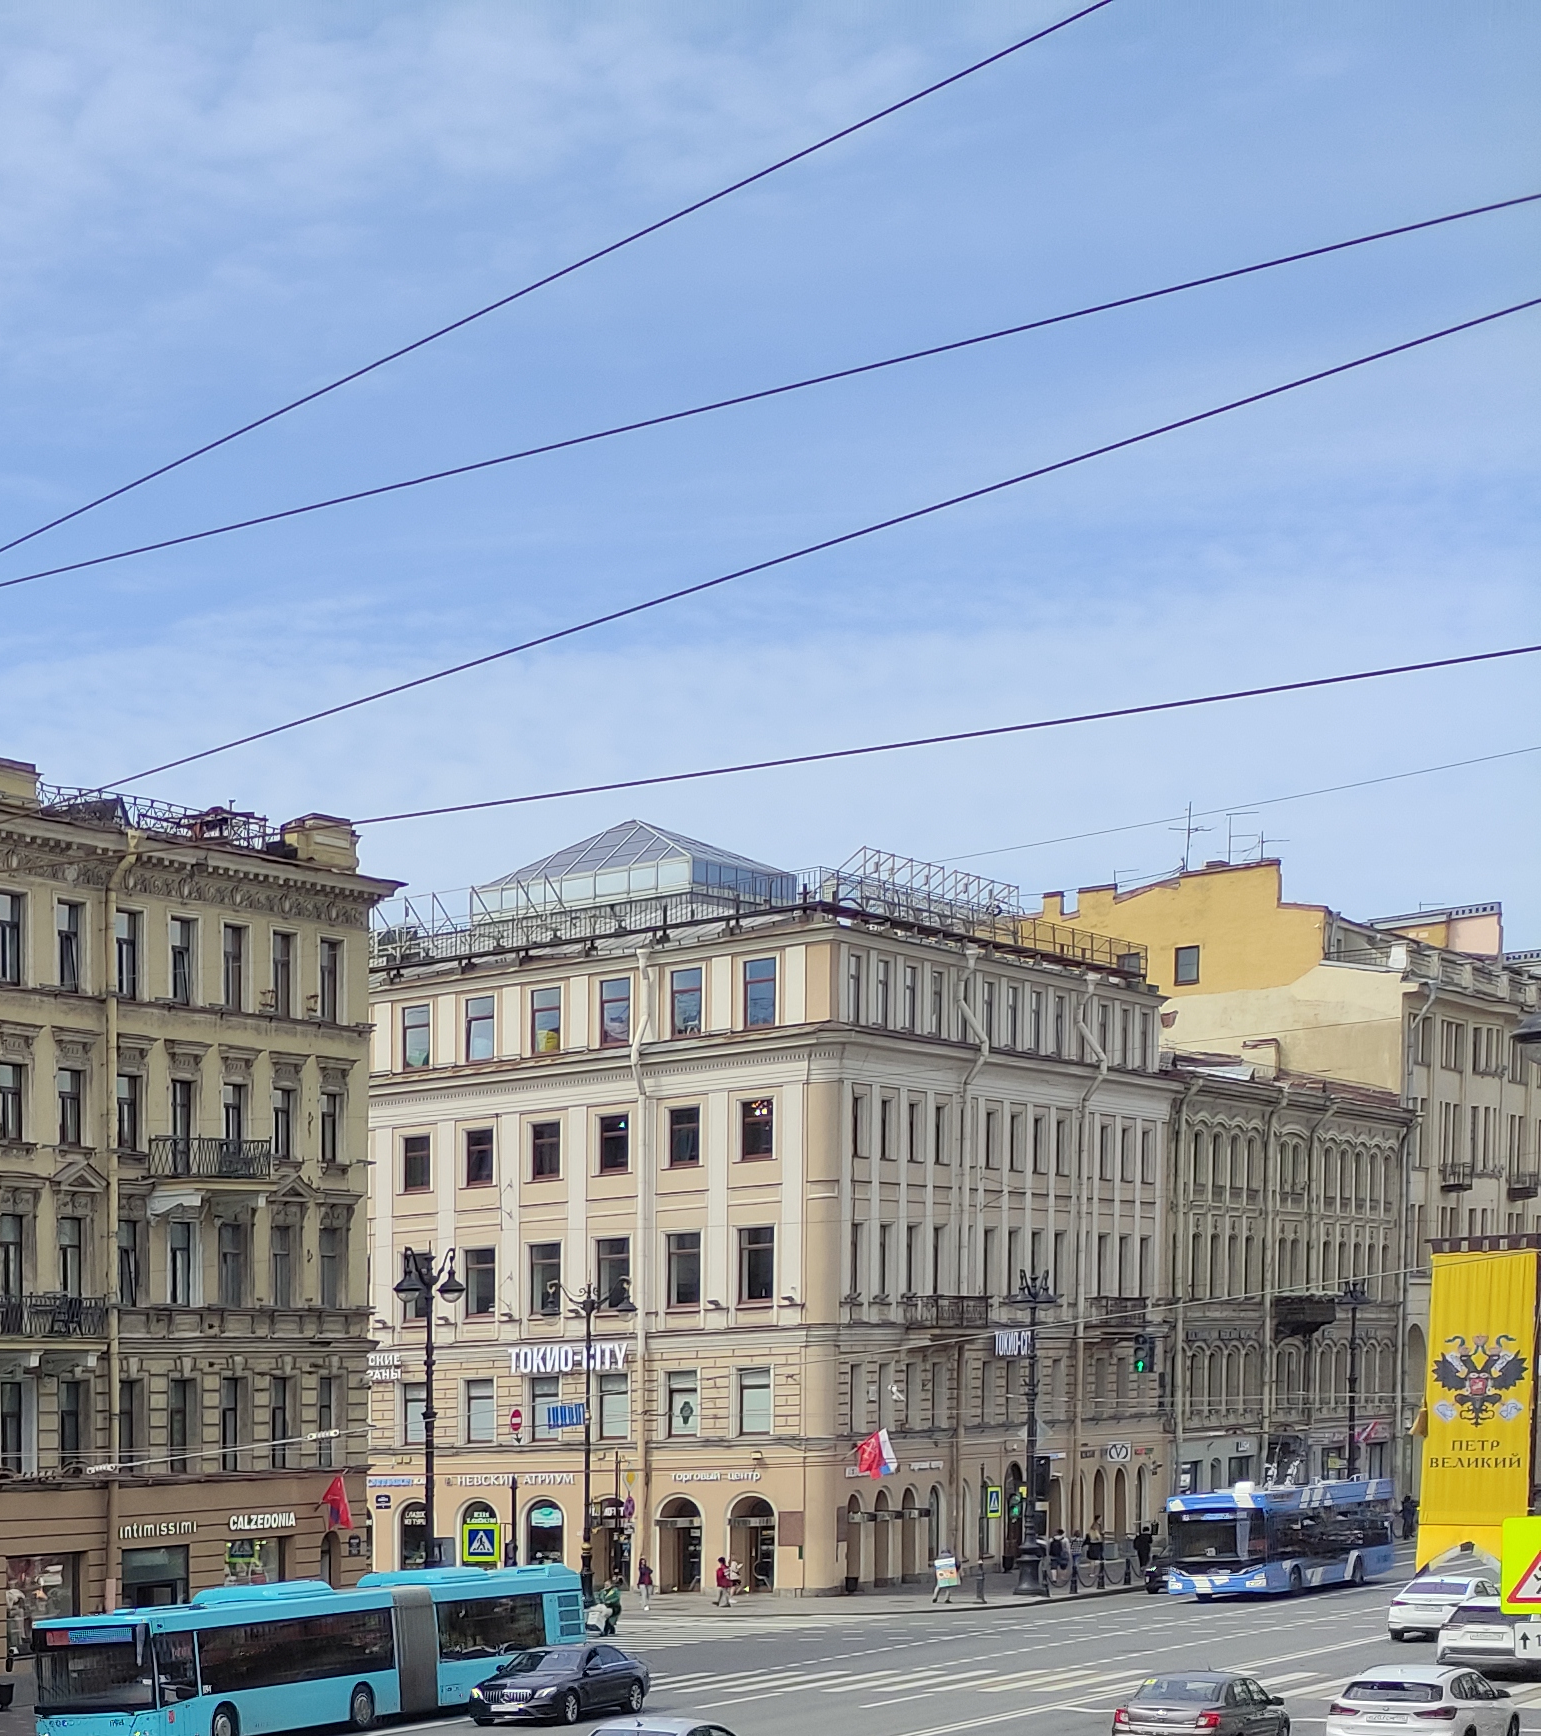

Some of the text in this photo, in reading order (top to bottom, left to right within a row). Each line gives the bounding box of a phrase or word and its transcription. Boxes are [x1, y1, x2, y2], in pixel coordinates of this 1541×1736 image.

[1450, 1439, 1501, 1452] ПЕТР
[1429, 1452, 1522, 1469] ВЕЛИКИЙ
[523, 1473, 576, 1486] АТРИУМ
[228, 1511, 297, 1531] CALZEDONIA
